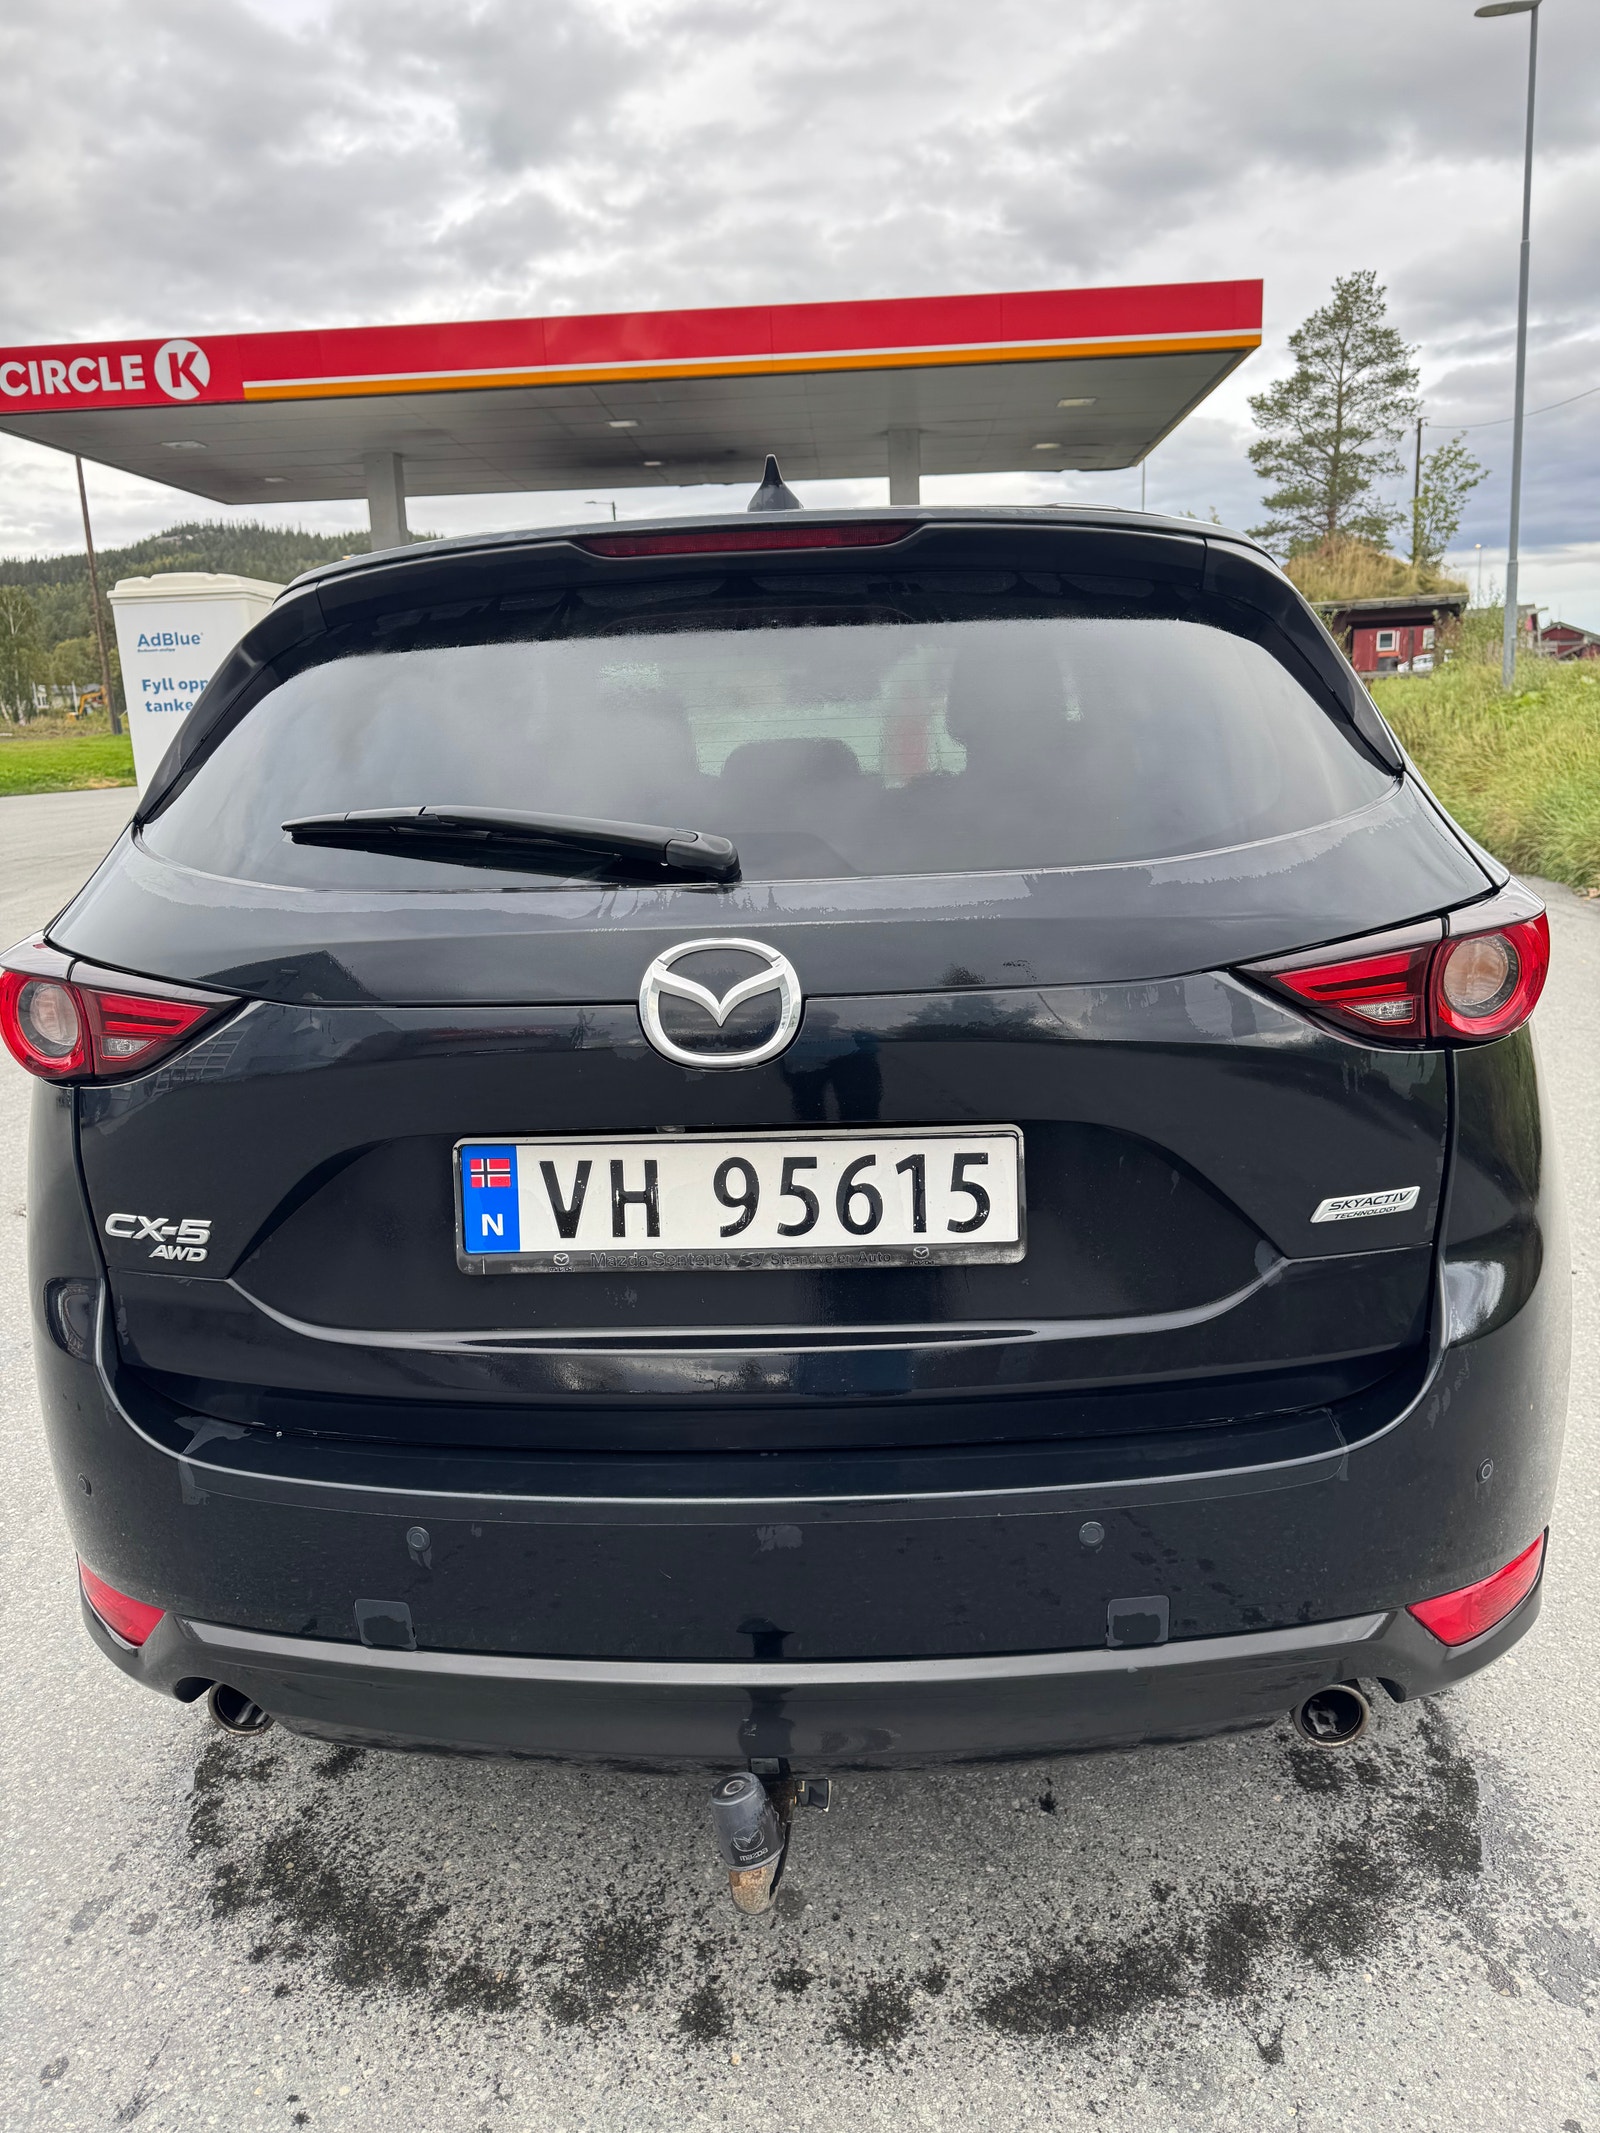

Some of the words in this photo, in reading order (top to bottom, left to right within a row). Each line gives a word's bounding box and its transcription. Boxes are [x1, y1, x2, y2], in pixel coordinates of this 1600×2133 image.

[0, 354, 146, 397] CIRCLE
[160, 345, 209, 400] K
[137, 632, 201, 647] AdBlue
[142, 678, 175, 694] Fyll
[539, 1159, 660, 1239] VH
[713, 1152, 991, 1238] 95615
[1328, 1191, 1411, 1211] SKYACTIV
[1334, 1205, 1400, 1219] TECHNOLOGY
[105, 1213, 212, 1245] CX-5
[481, 1213, 504, 1236] N
[148, 1244, 208, 1262] AWD
[590, 1252, 649, 1268] Mazda
[857, 1251, 892, 1263] Auto
